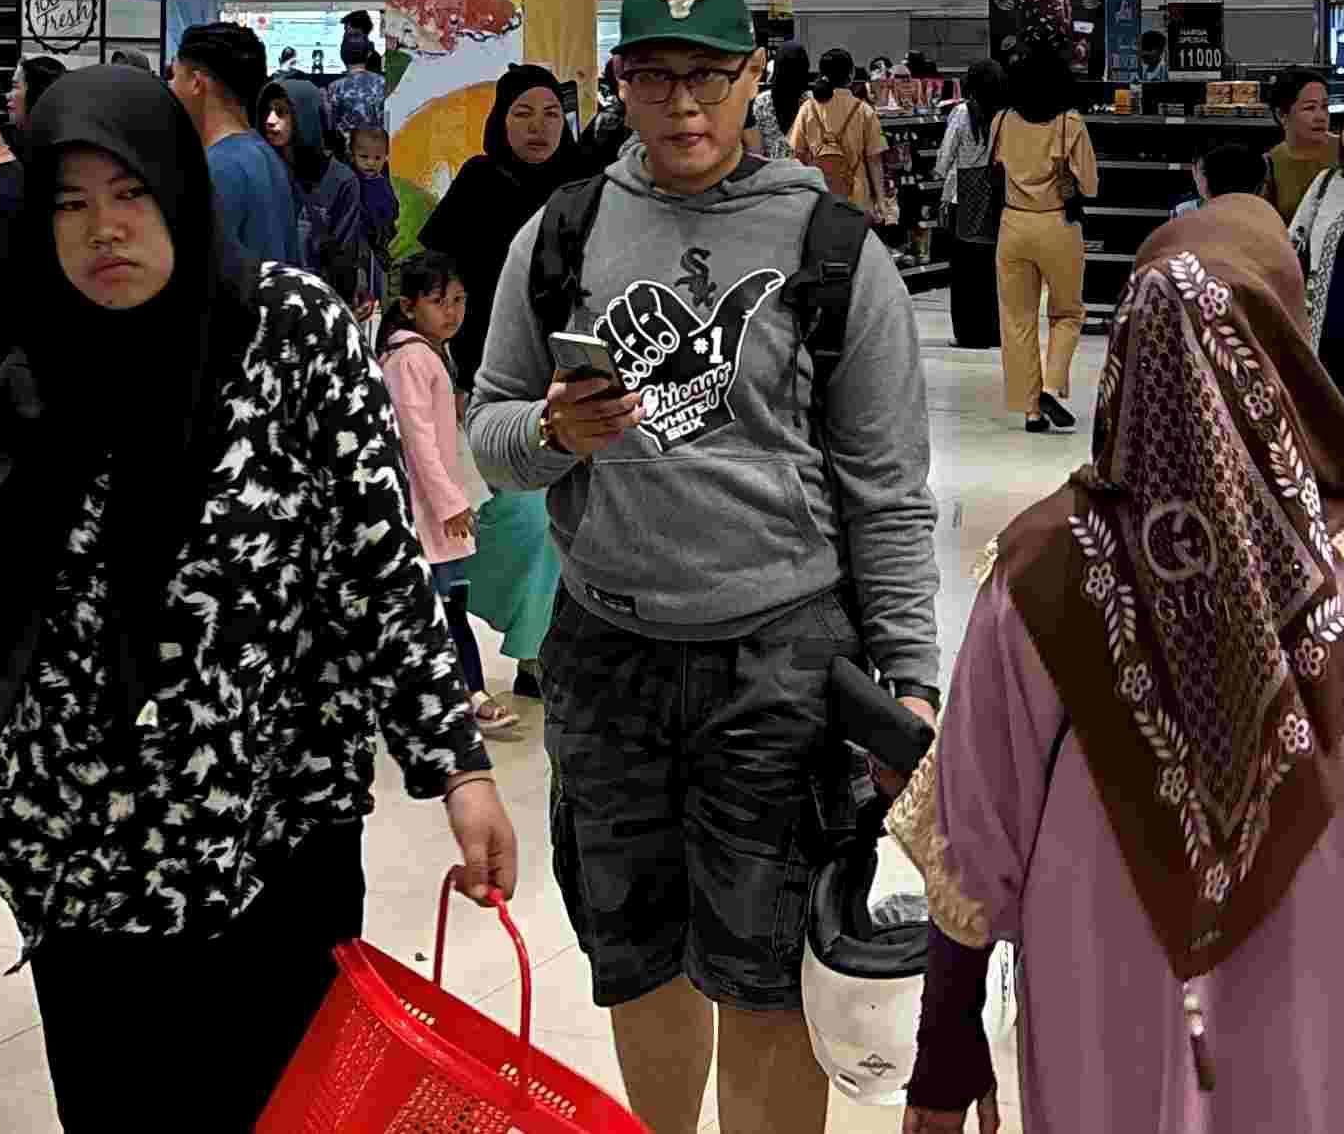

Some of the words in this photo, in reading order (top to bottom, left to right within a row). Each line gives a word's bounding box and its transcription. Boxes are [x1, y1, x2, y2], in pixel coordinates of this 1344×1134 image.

[1178, 48, 1223, 67] 11000
[693, 326, 723, 364] #1
[639, 362, 732, 425] Chicago
[651, 401, 710, 433] WHITE
[665, 415, 706, 441] SOX
